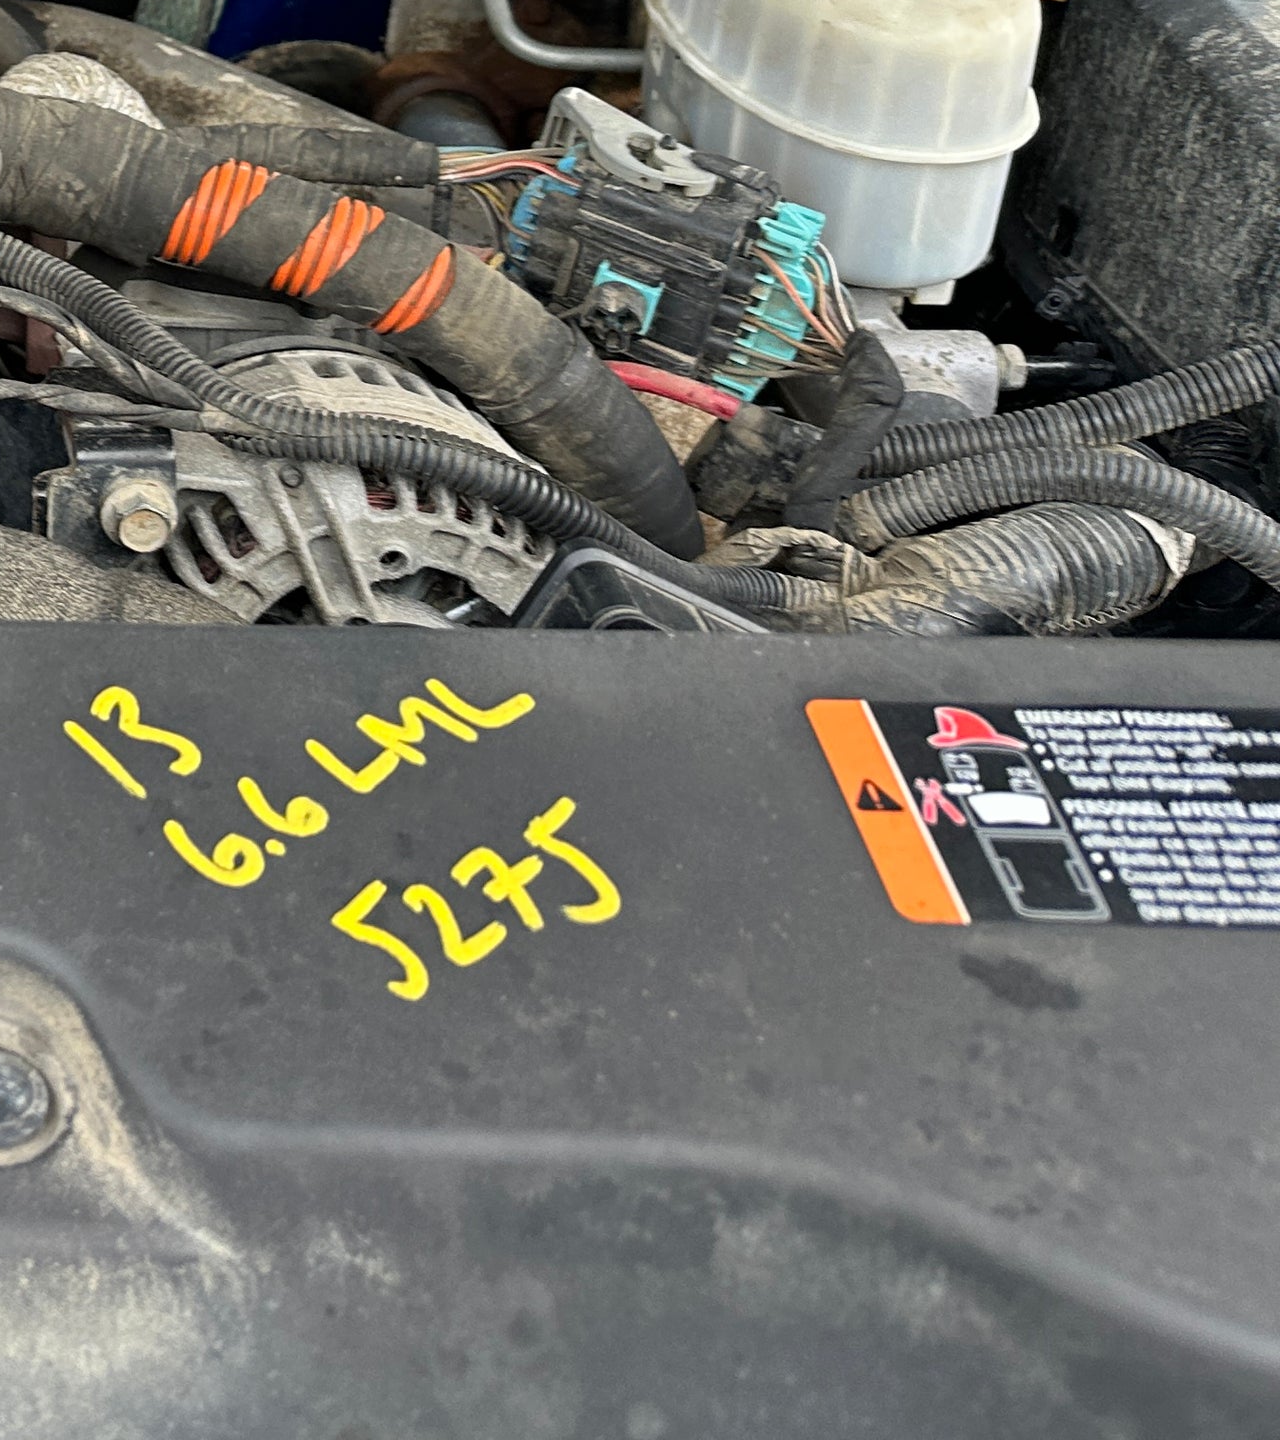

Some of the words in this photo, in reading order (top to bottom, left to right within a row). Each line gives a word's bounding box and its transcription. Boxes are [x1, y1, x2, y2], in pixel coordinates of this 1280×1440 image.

[64, 685, 203, 800] 13
[163, 776, 330, 888] 6.6
[305, 677, 537, 794] LML
[331, 795, 622, 1002] 5275
